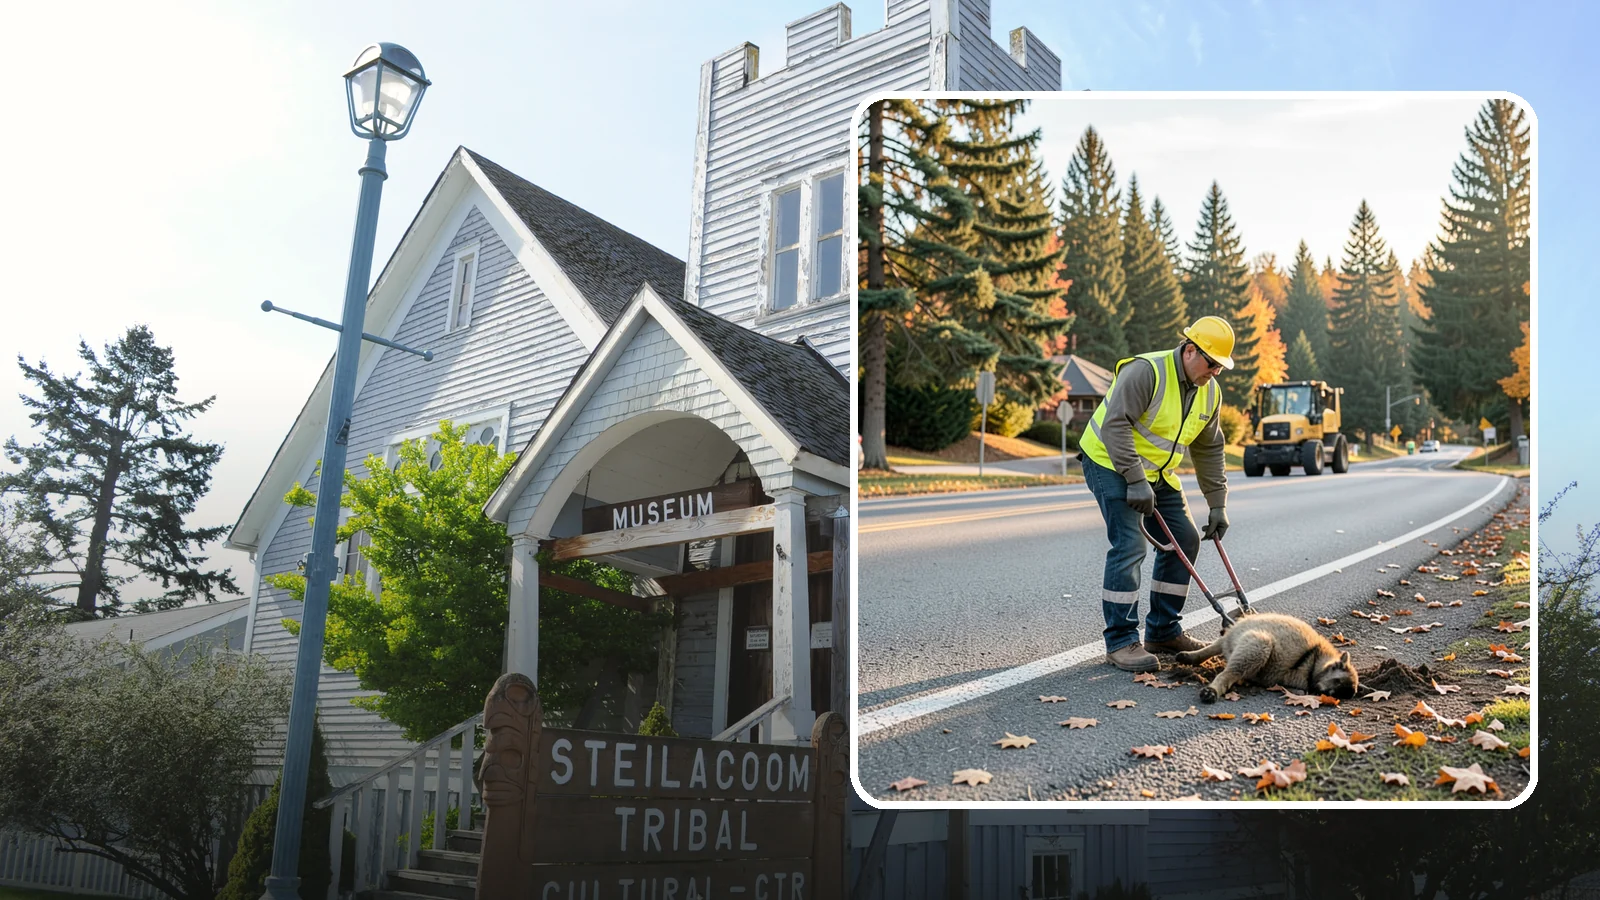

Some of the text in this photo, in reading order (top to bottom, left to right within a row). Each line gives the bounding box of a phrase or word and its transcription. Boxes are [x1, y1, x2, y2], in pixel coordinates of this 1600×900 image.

[613, 492, 713, 530] MUSEUM
[551, 738, 809, 792] STEILACOOM
[615, 807, 757, 851] TRIBAL
